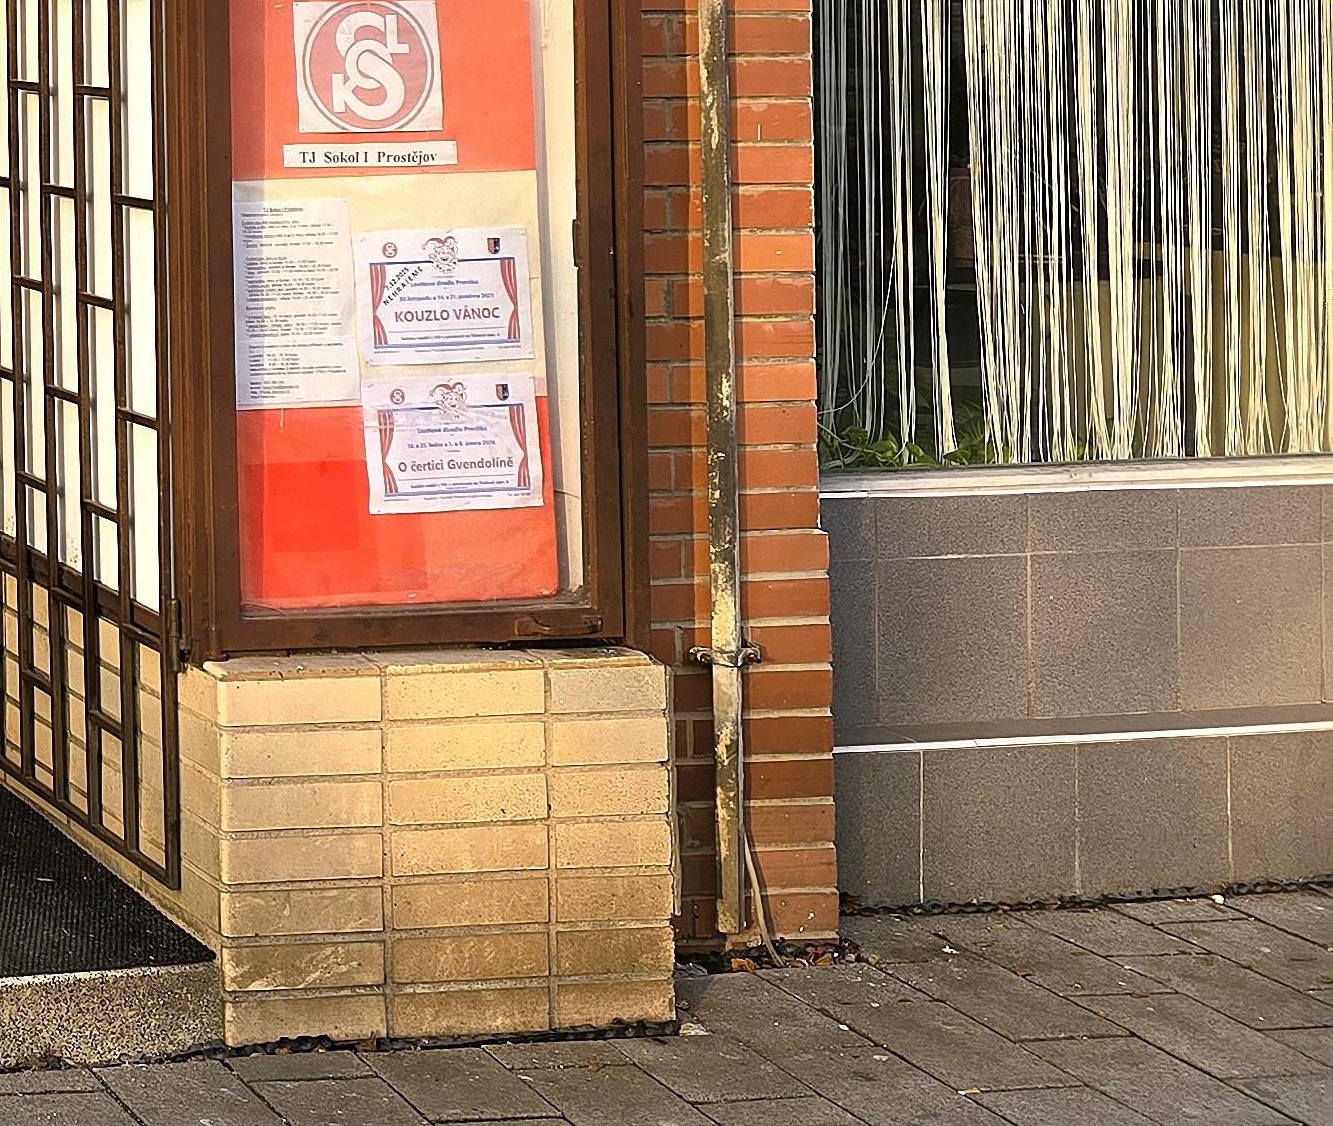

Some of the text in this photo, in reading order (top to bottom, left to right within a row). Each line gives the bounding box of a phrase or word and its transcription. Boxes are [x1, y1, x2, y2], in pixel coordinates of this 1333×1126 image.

[298, 150, 317, 164] TJ
[323, 150, 360, 164] Sokol
[376, 149, 438, 166] Prostějov
[394, 304, 500, 323] KOUZLO VÁNOC
[398, 461, 408, 473] O
[447, 455, 514, 471] Gvendolíně
